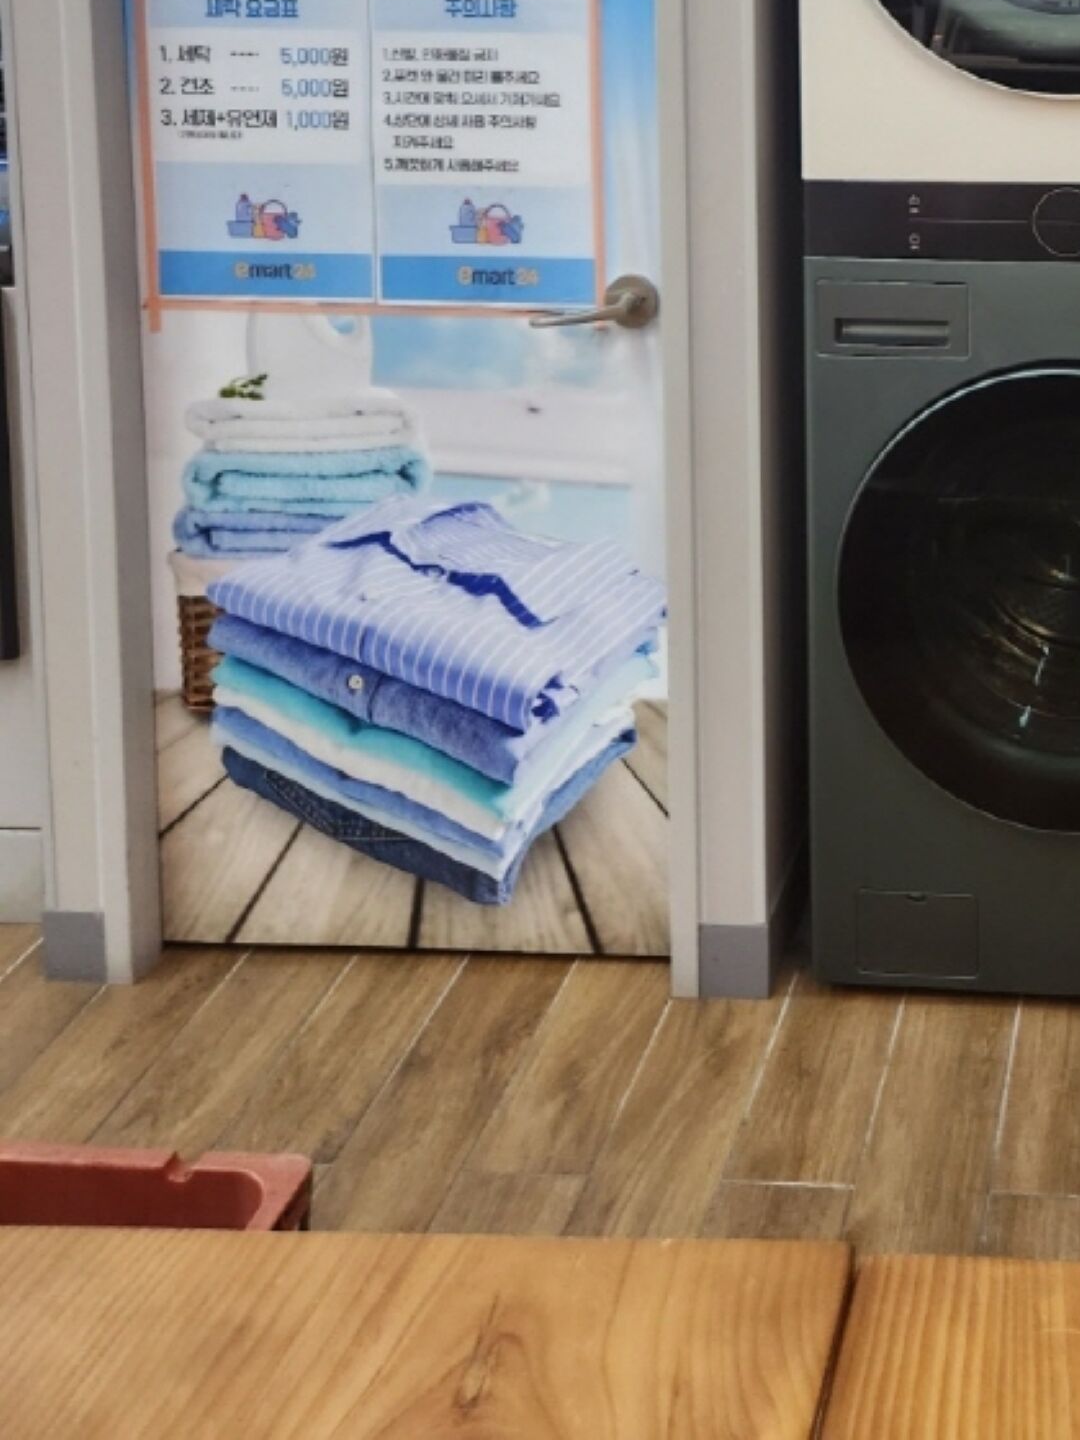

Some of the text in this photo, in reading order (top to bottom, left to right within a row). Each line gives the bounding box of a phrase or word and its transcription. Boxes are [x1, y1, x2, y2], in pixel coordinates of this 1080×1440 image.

[159, 45, 349, 66] 1. 세탁 5,000원
[159, 77, 349, 98] 2. 건조 5,000원
[160, 109, 349, 131] 3. 세제+유연제 1,000원
